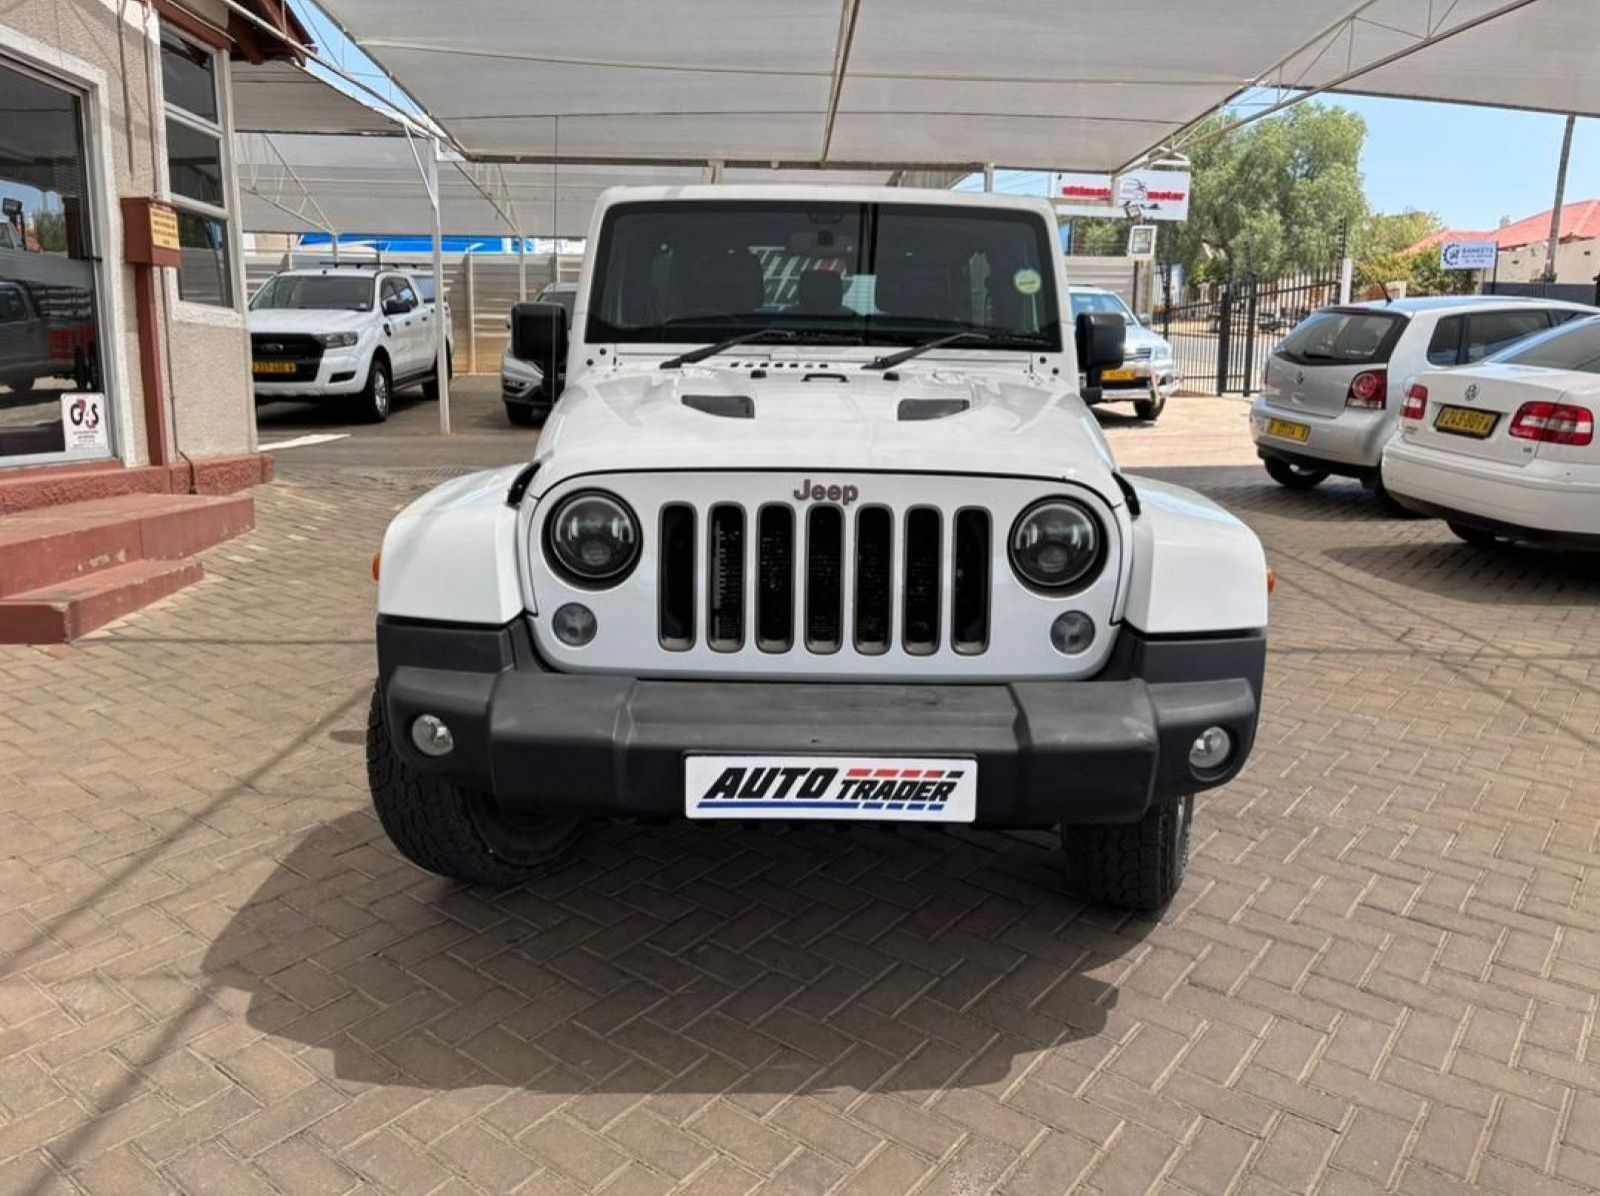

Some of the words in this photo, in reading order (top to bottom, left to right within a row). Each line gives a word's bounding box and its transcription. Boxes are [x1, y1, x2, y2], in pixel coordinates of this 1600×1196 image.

[793, 479, 859, 506] Jeep
[703, 767, 839, 800] AUTO
[836, 780, 958, 802] TRADER
